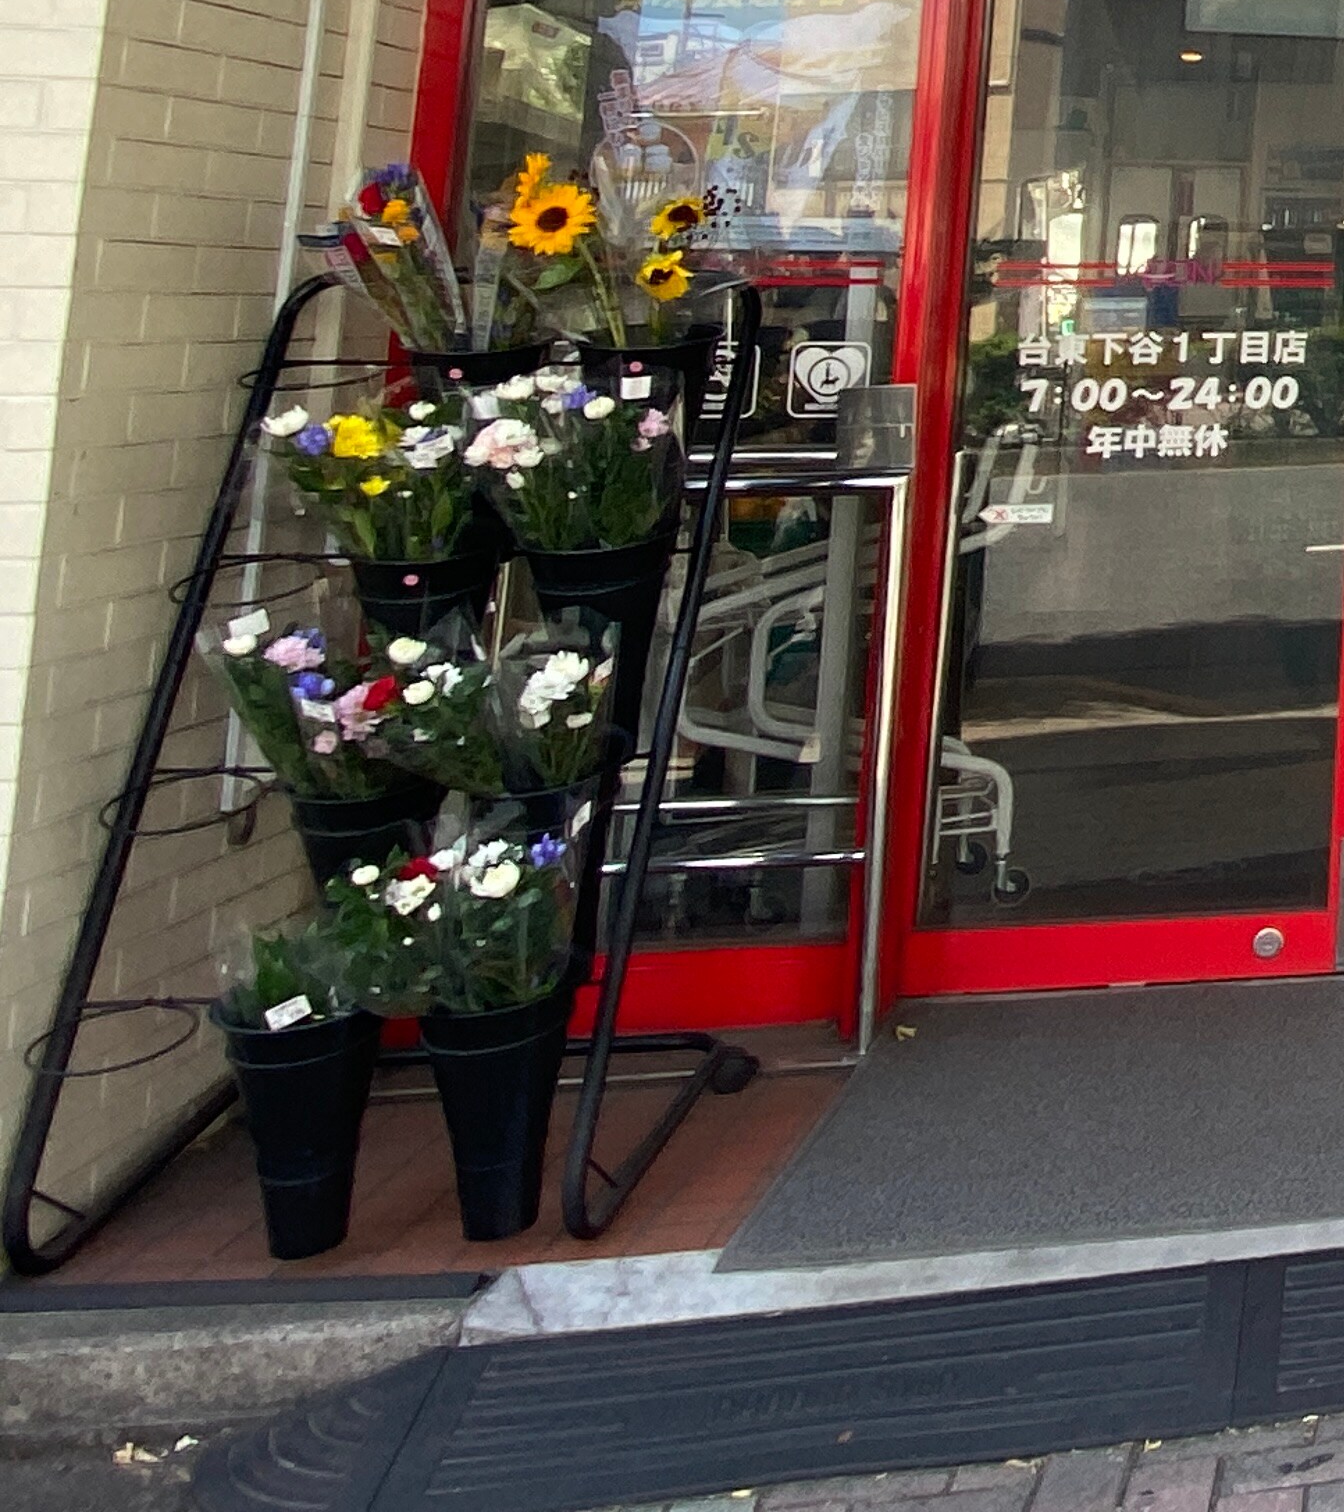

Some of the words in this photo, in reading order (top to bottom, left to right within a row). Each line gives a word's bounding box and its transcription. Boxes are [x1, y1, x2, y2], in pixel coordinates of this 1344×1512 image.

[1018, 330, 1309, 367] 台東下谷1丁目店
[1086, 424, 1229, 459] 年中無休
